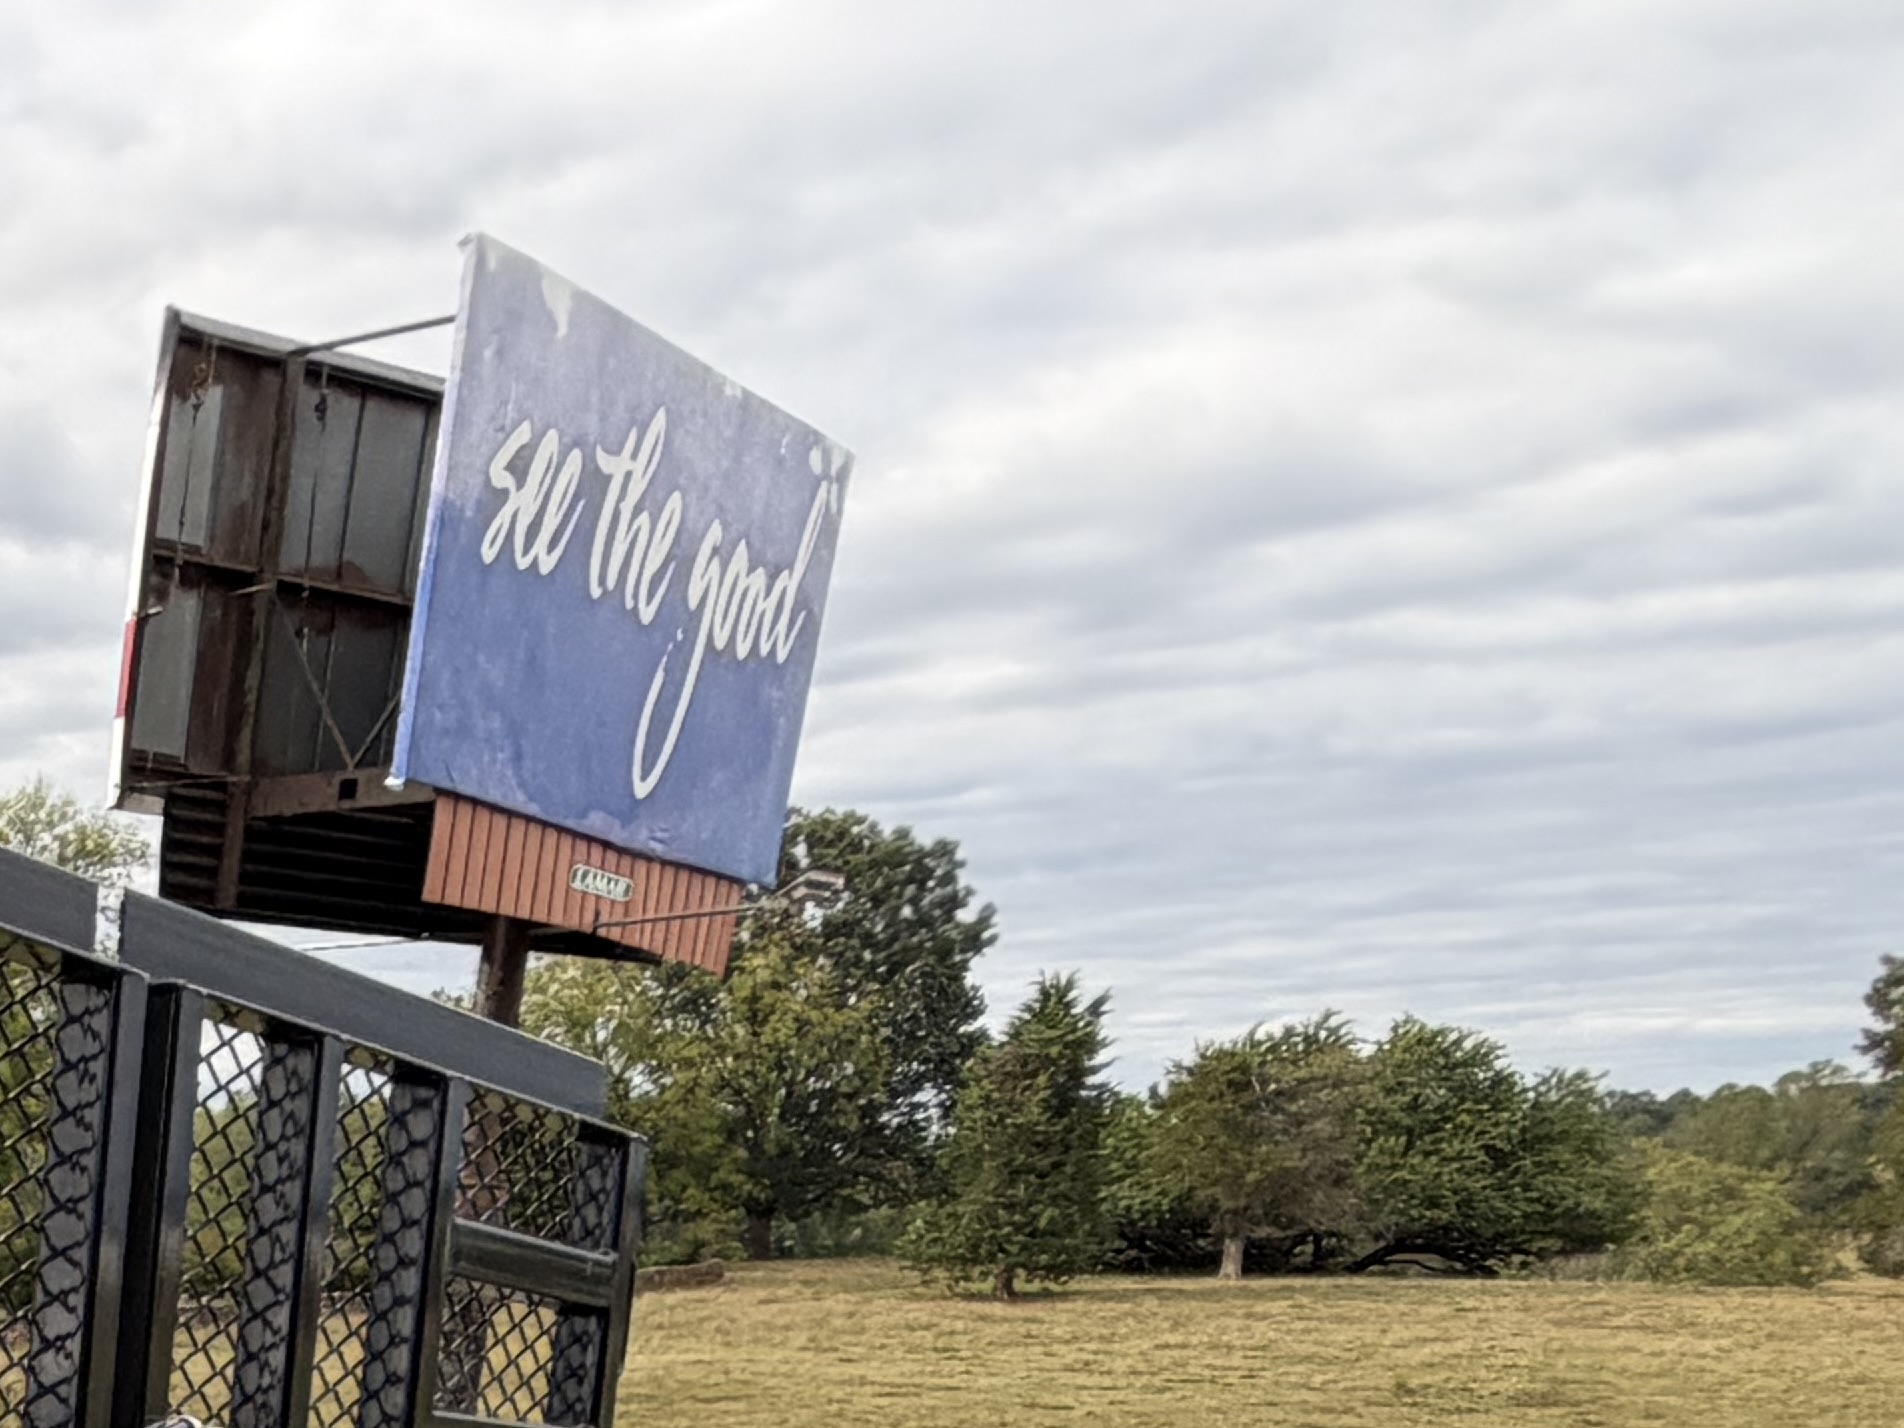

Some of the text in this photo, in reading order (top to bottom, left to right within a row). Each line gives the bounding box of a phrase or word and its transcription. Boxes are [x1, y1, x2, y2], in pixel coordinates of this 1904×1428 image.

[480, 406, 828, 801] see the good
